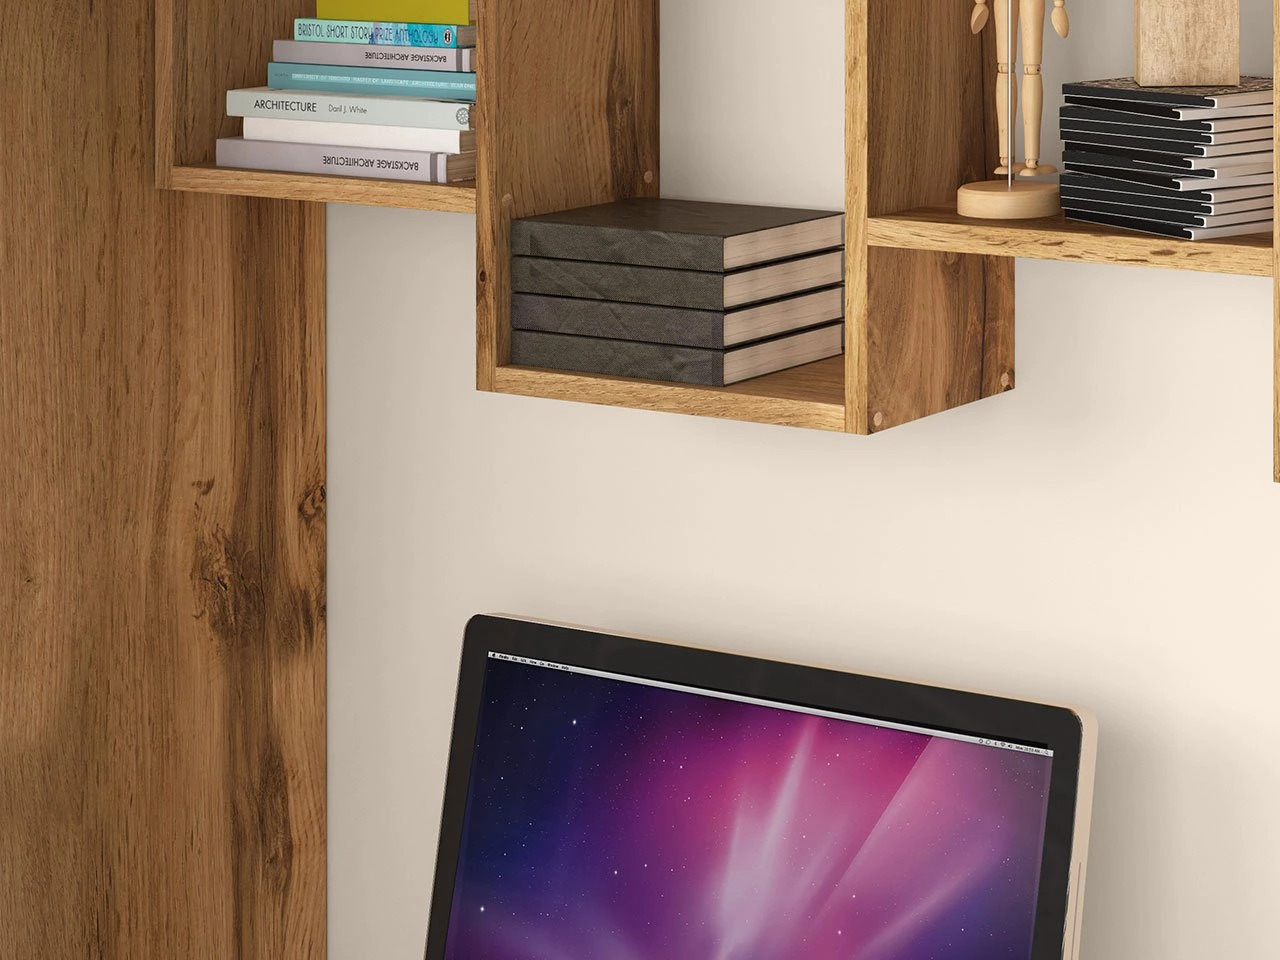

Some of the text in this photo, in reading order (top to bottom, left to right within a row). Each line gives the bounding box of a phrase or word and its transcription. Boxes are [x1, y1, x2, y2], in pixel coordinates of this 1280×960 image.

[298, 23, 324, 38] BRISTOL
[327, 24, 349, 39] SHORT
[375, 26, 393, 42] PRIZE
[365, 51, 447, 63] BACKSTAGE ARCHITECTURE
[254, 99, 317, 112] ARCHITECTURE
[349, 105, 367, 115] White
[322, 155, 419, 171] BACKSTAGE ARCHITECTURE
